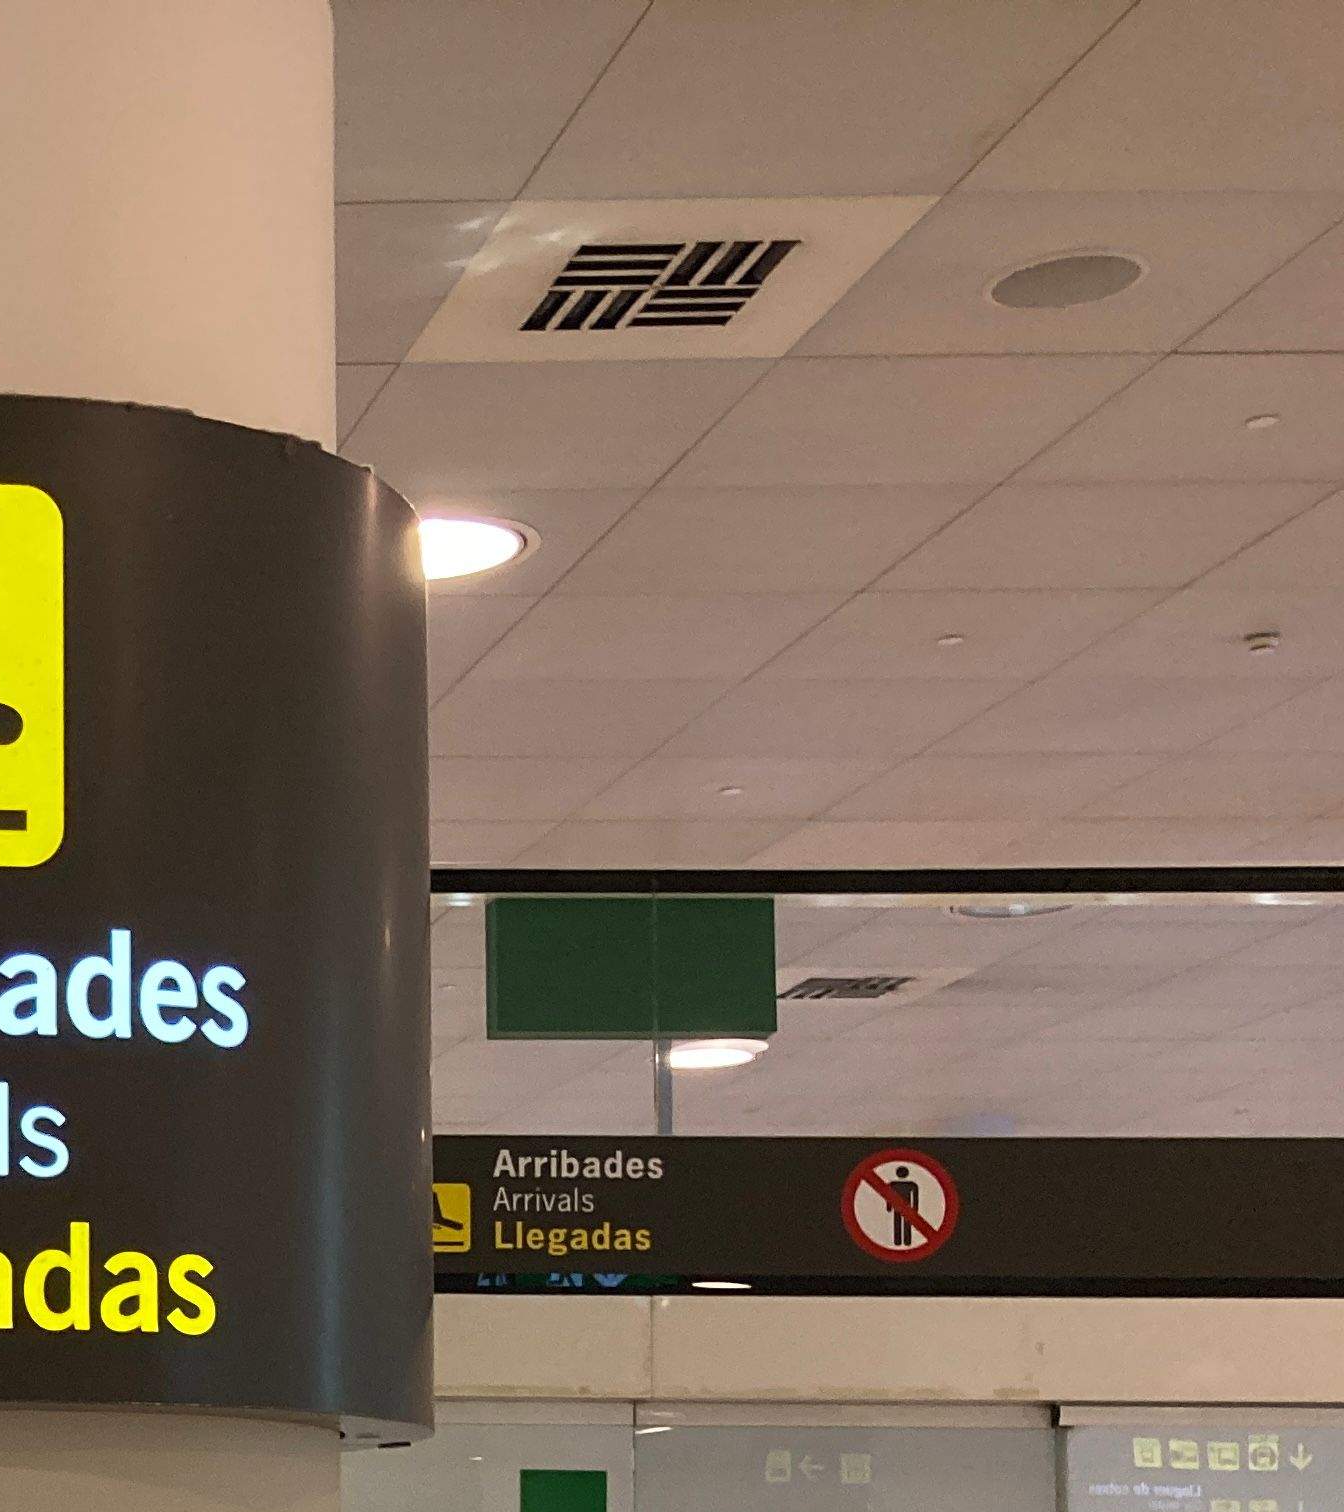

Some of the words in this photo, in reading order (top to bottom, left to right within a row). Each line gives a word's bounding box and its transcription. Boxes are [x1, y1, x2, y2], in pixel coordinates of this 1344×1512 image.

[493, 1149, 663, 1179] Arribades
[493, 1186, 594, 1212] Arrivals
[495, 1221, 652, 1256] Llegadas
